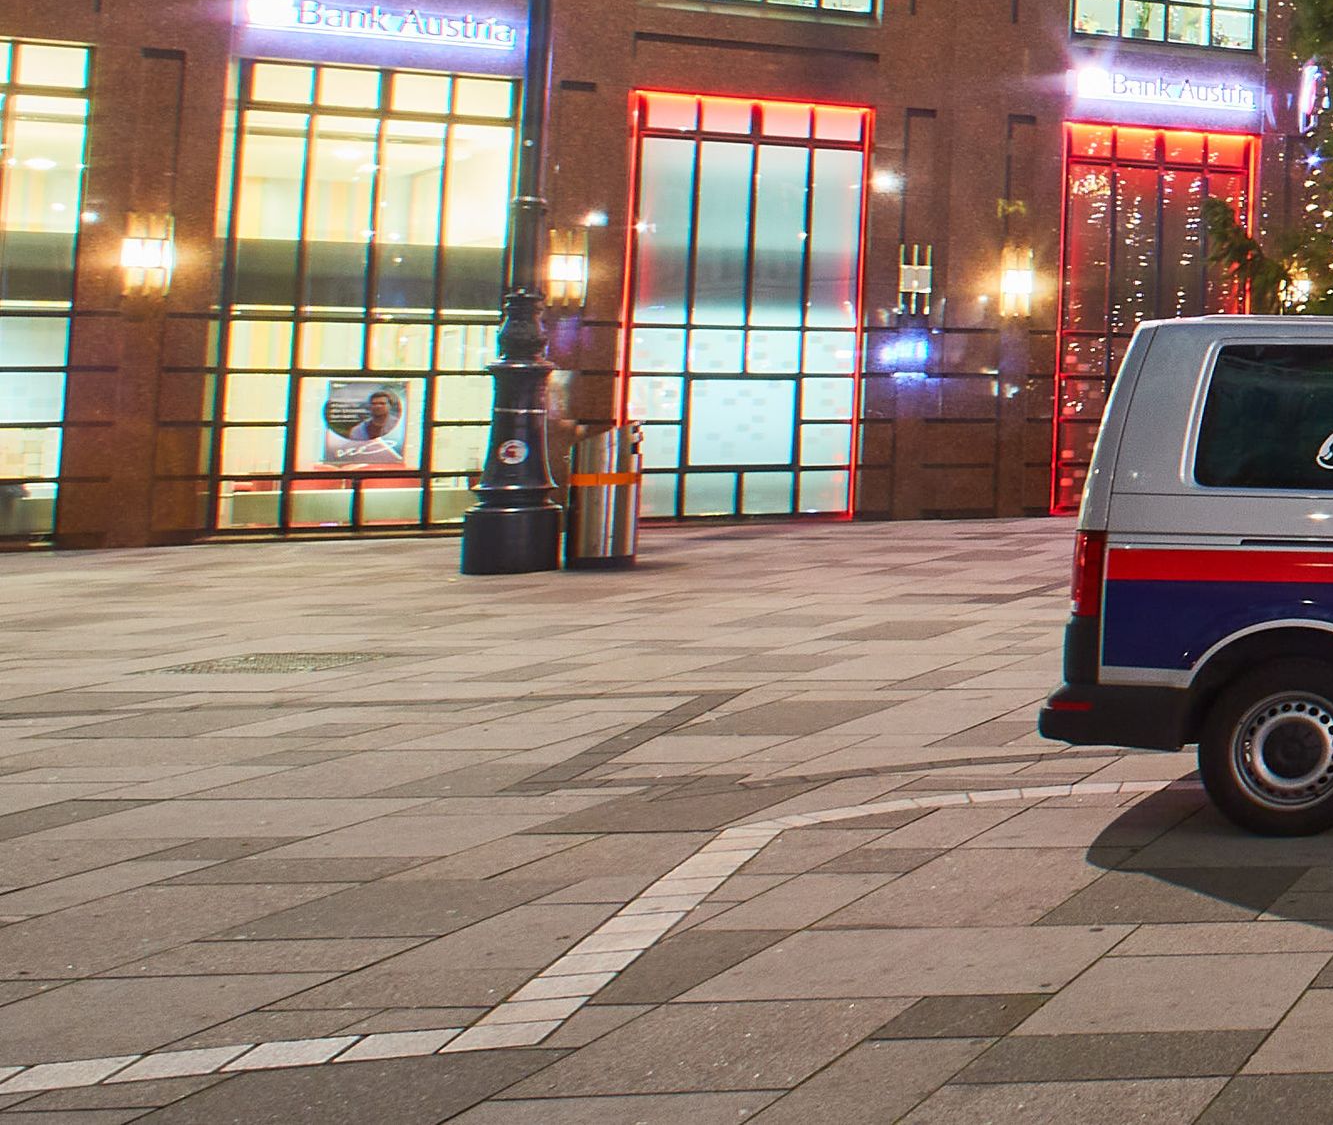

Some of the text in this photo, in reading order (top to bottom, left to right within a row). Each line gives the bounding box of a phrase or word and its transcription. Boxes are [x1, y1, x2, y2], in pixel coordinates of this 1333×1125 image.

[299, 0, 516, 43] Bank Austria
[1112, 73, 1255, 105] Bank Austria
